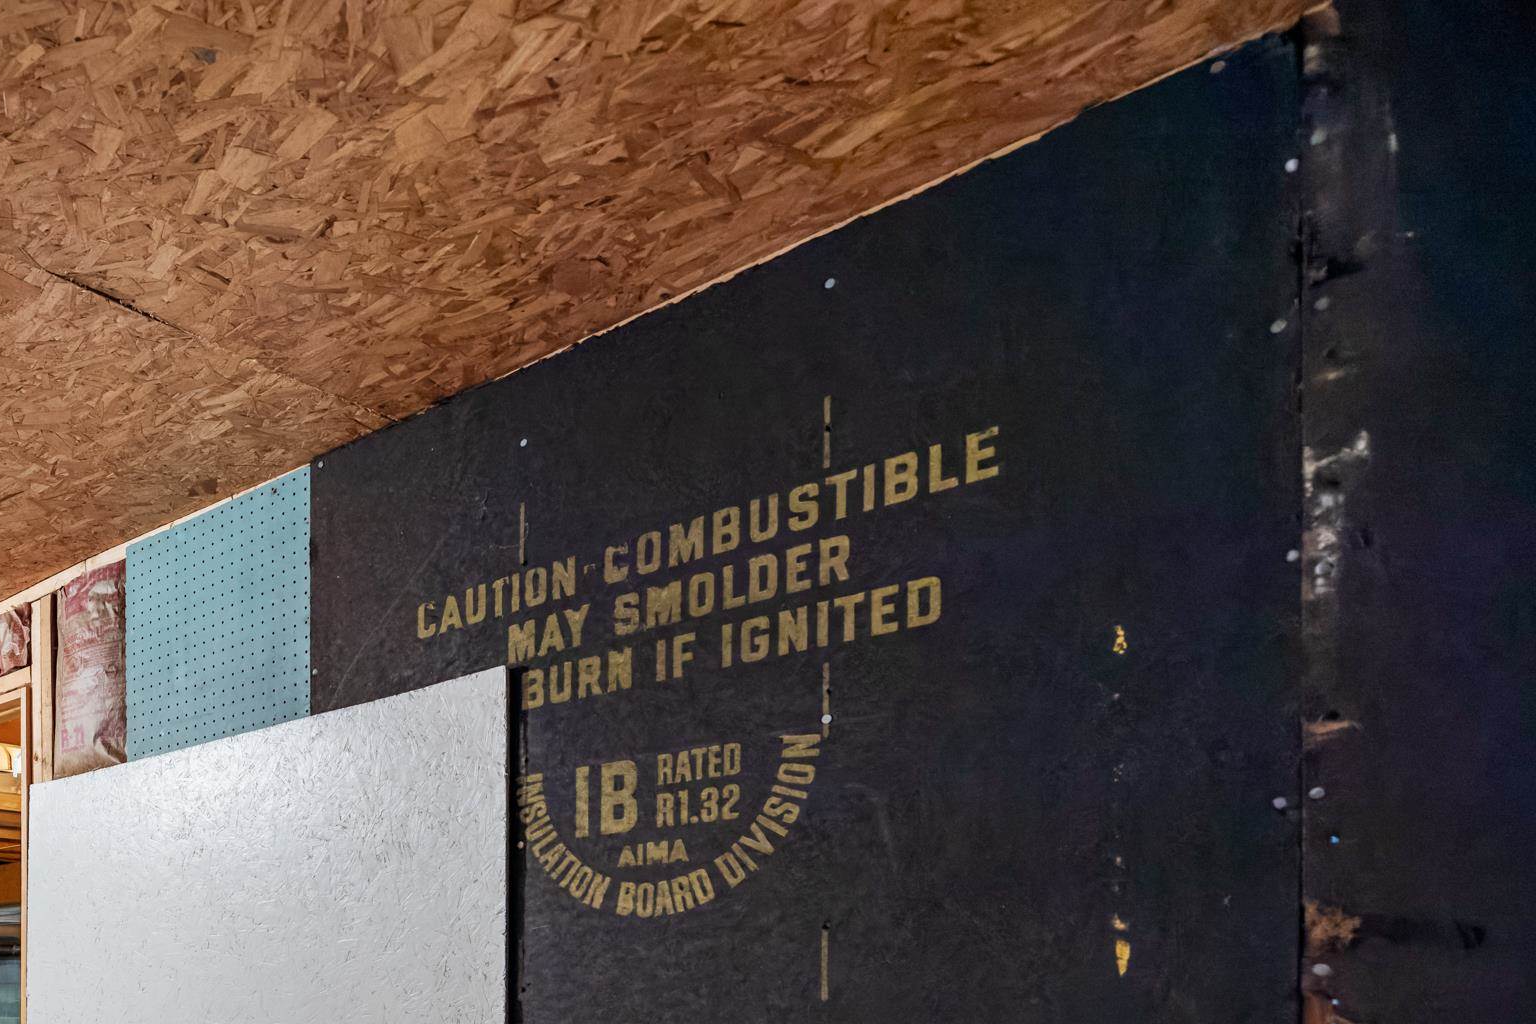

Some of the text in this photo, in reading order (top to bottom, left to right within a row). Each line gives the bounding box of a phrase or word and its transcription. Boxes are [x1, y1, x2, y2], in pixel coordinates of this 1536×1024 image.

[417, 556, 576, 640] CAUTION
[603, 425, 1000, 585] COMBUSTIBLE
[507, 534, 851, 665] MAY SMOLDER
[522, 575, 942, 711] BURN IF IGNITED
[574, 759, 640, 839] IB
[655, 783, 742, 829] R1.32
[656, 742, 742, 786] RATED
[515, 733, 822, 918] INSULATION BOARD DIVISION
[617, 838, 690, 868] AIMA
